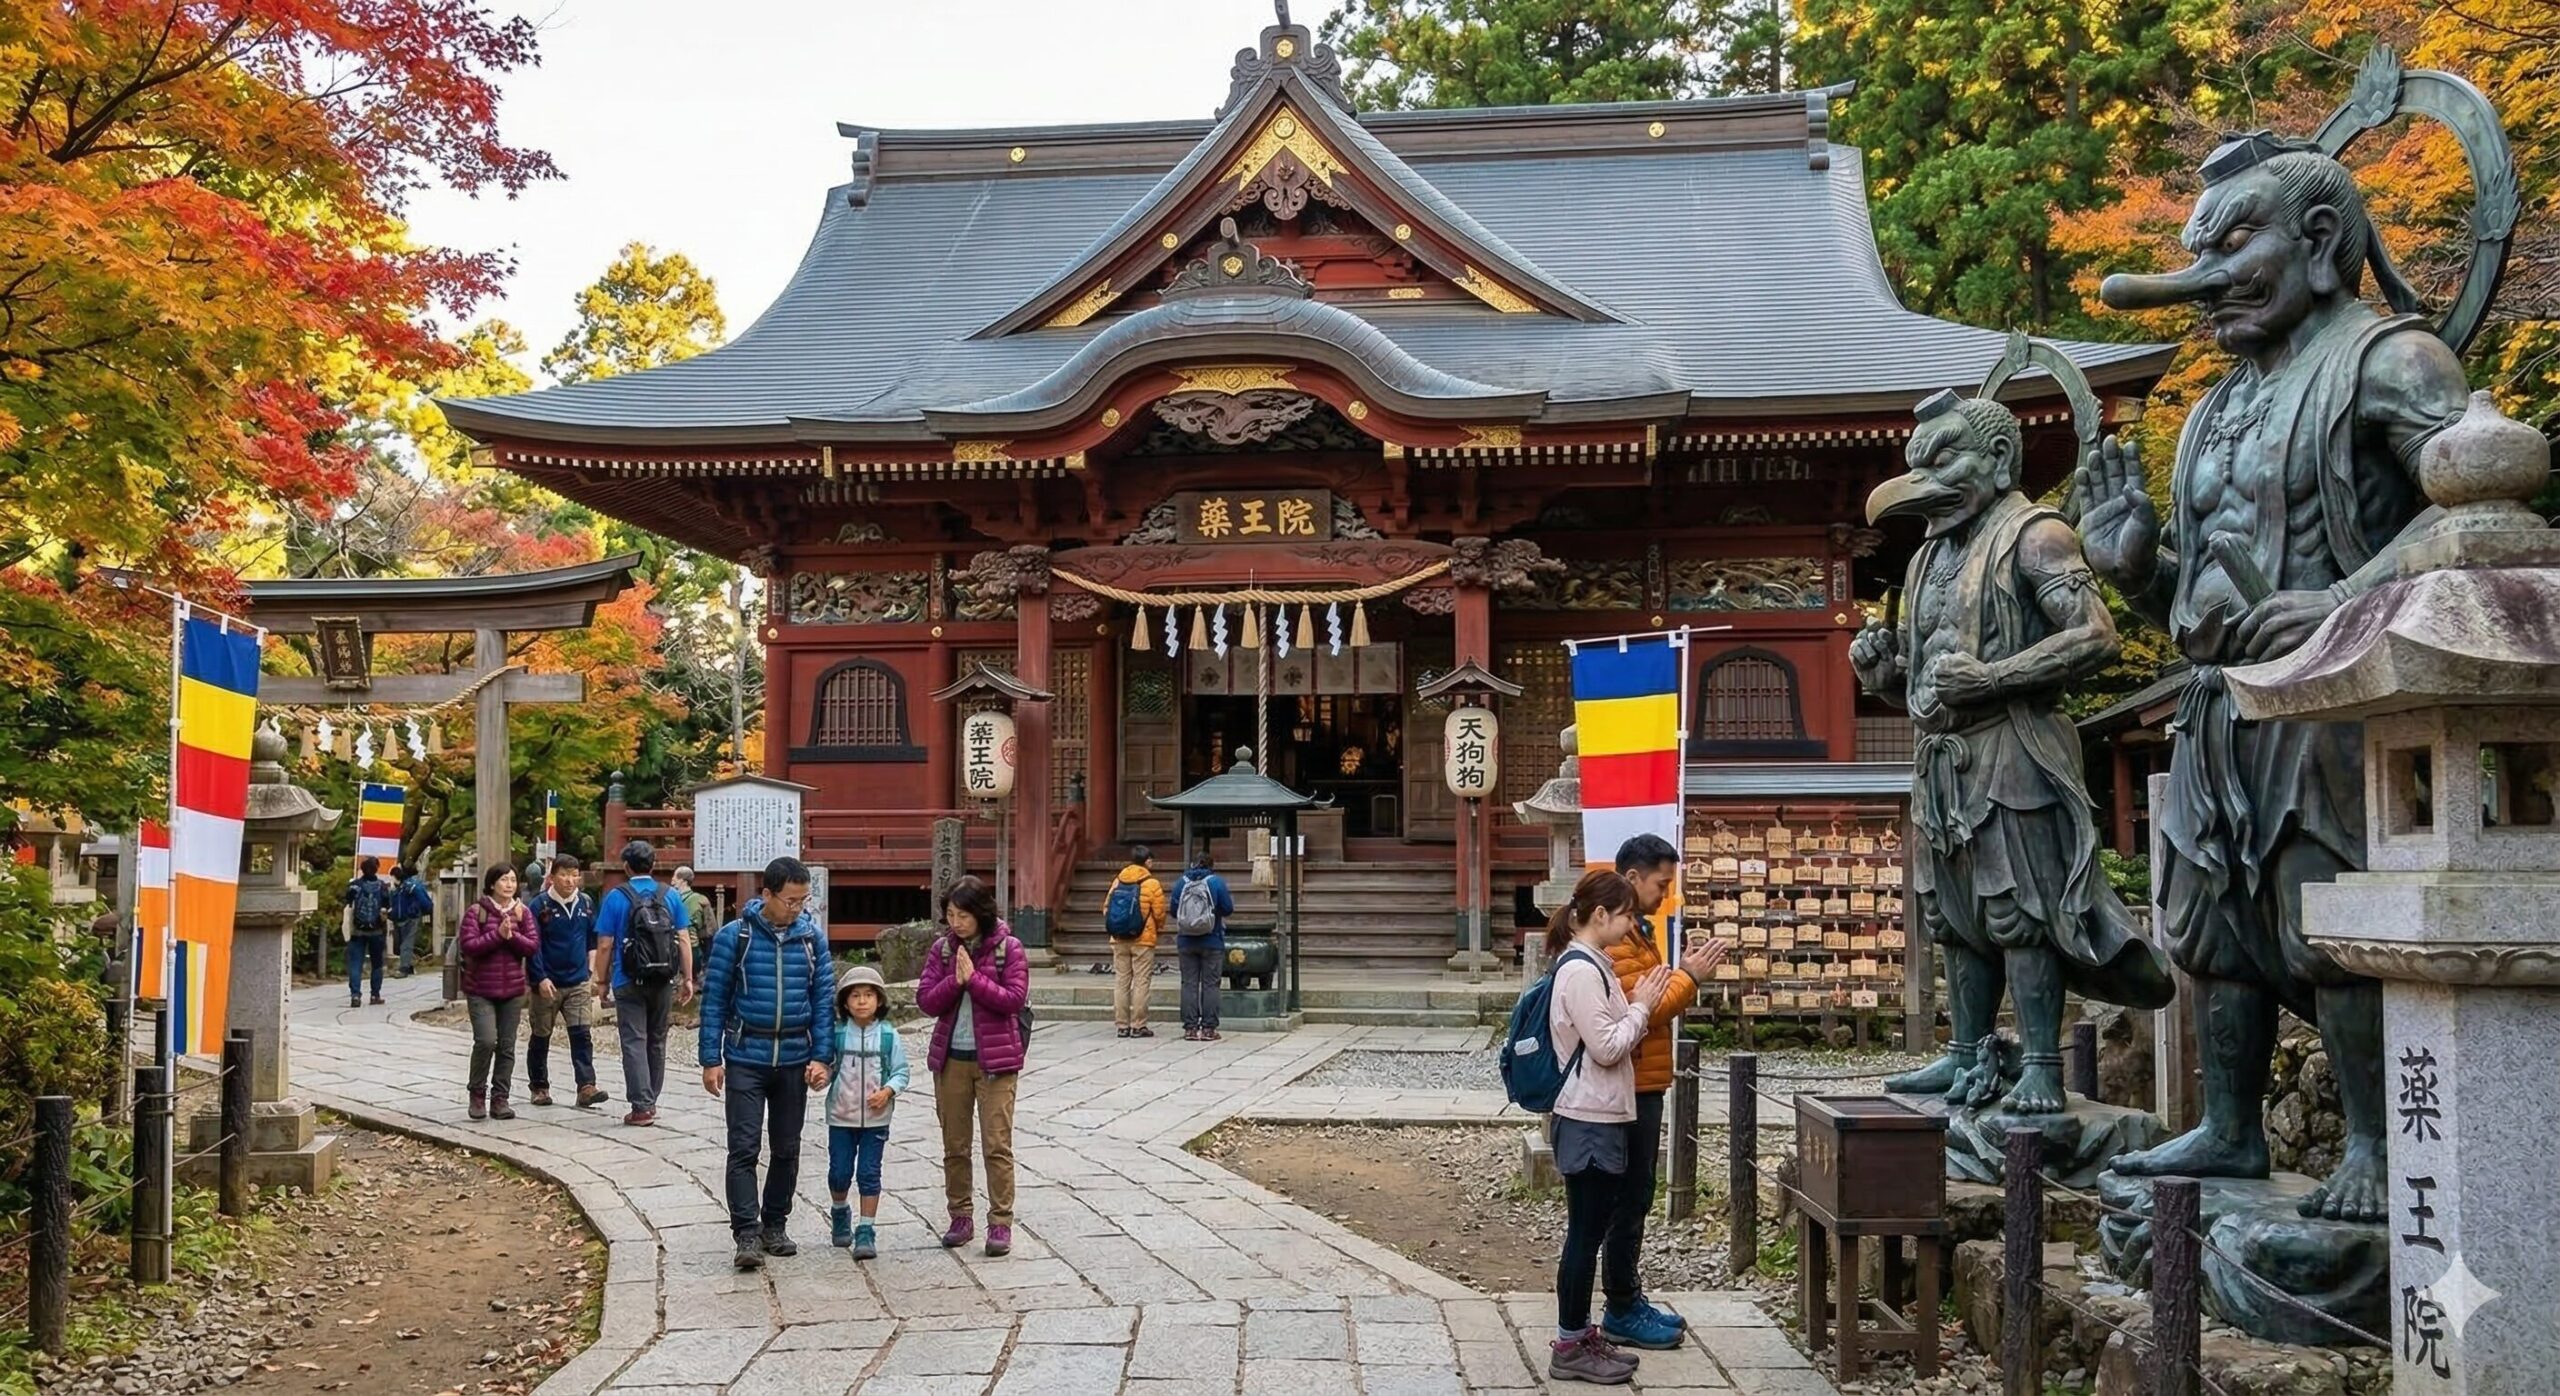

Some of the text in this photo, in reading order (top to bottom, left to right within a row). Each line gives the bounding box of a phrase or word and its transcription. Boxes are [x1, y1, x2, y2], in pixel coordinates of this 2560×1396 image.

[1198, 497, 1315, 538] 薬王院
[969, 721, 996, 790] 薬王院
[1456, 717, 1486, 788] 天狗狗
[2397, 1046, 2451, 1380] 薬王院
